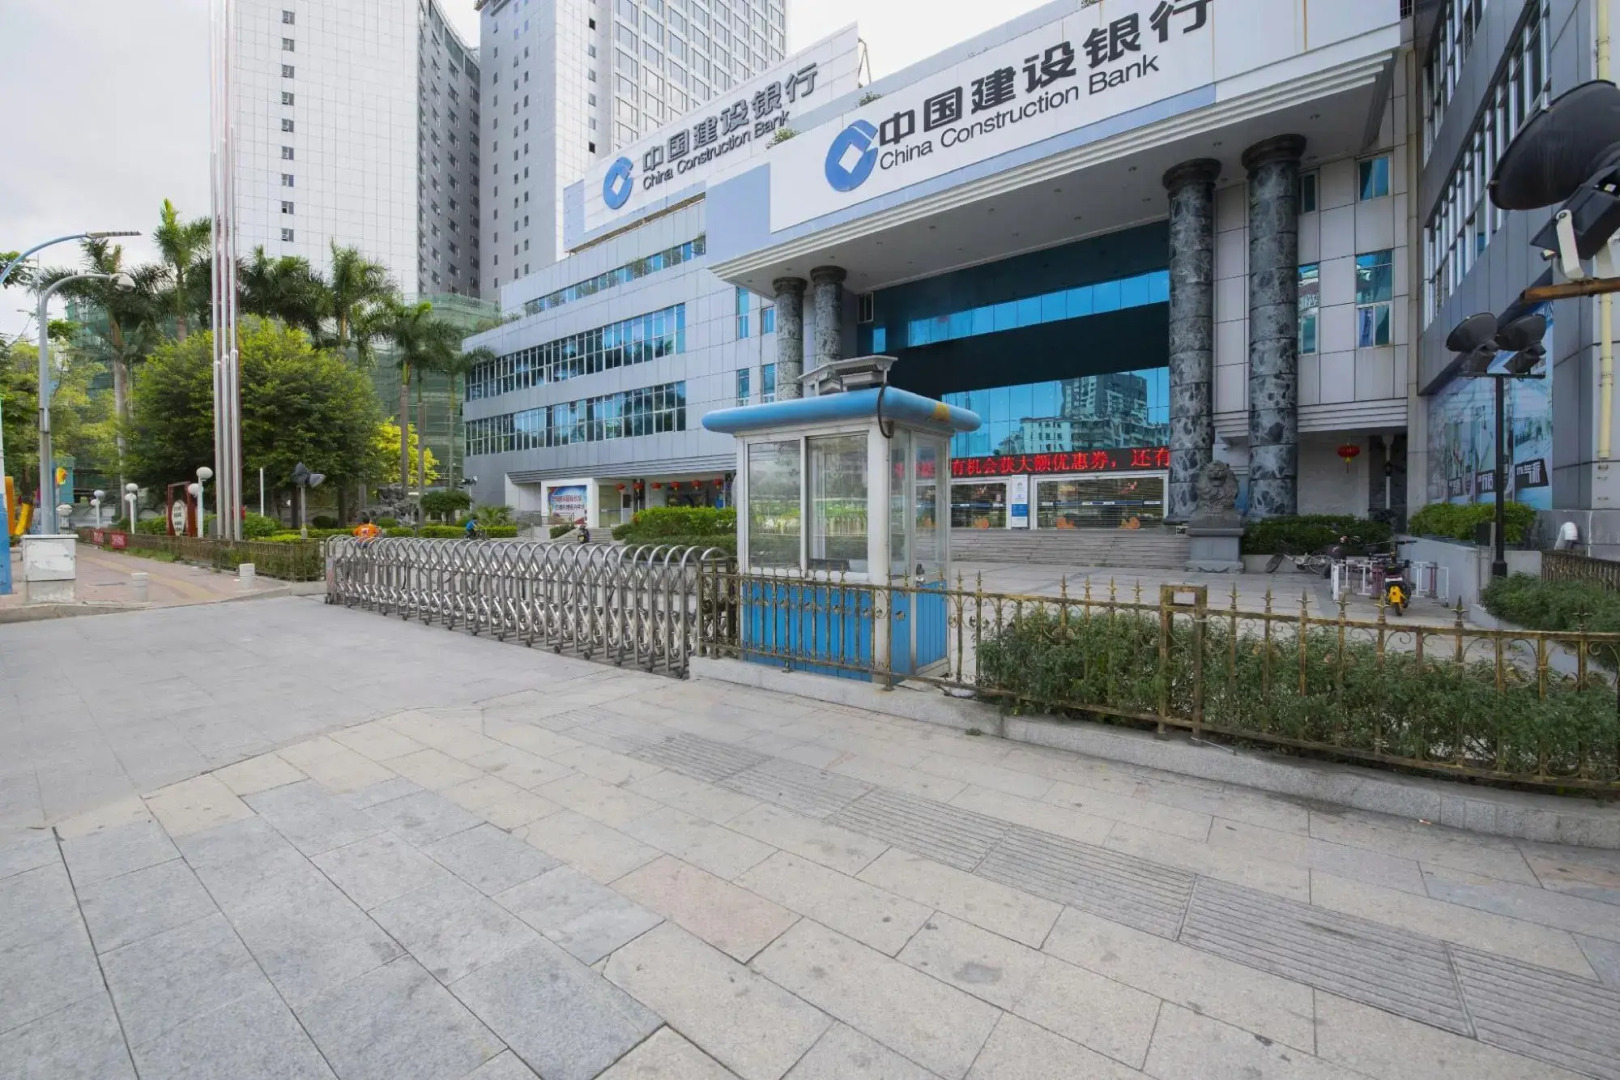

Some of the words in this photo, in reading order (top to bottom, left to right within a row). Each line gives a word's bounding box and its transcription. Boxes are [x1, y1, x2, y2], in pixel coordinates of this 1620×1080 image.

[643, 63, 817, 172] 中国建设银行
[879, 0, 1207, 145] 中国建设银行
[879, 139, 934, 170] China
[940, 85, 1079, 148] Construction
[1087, 54, 1160, 94] Bank
[643, 165, 673, 190] China
[676, 129, 752, 175] Construction
[753, 110, 791, 139] Bank
